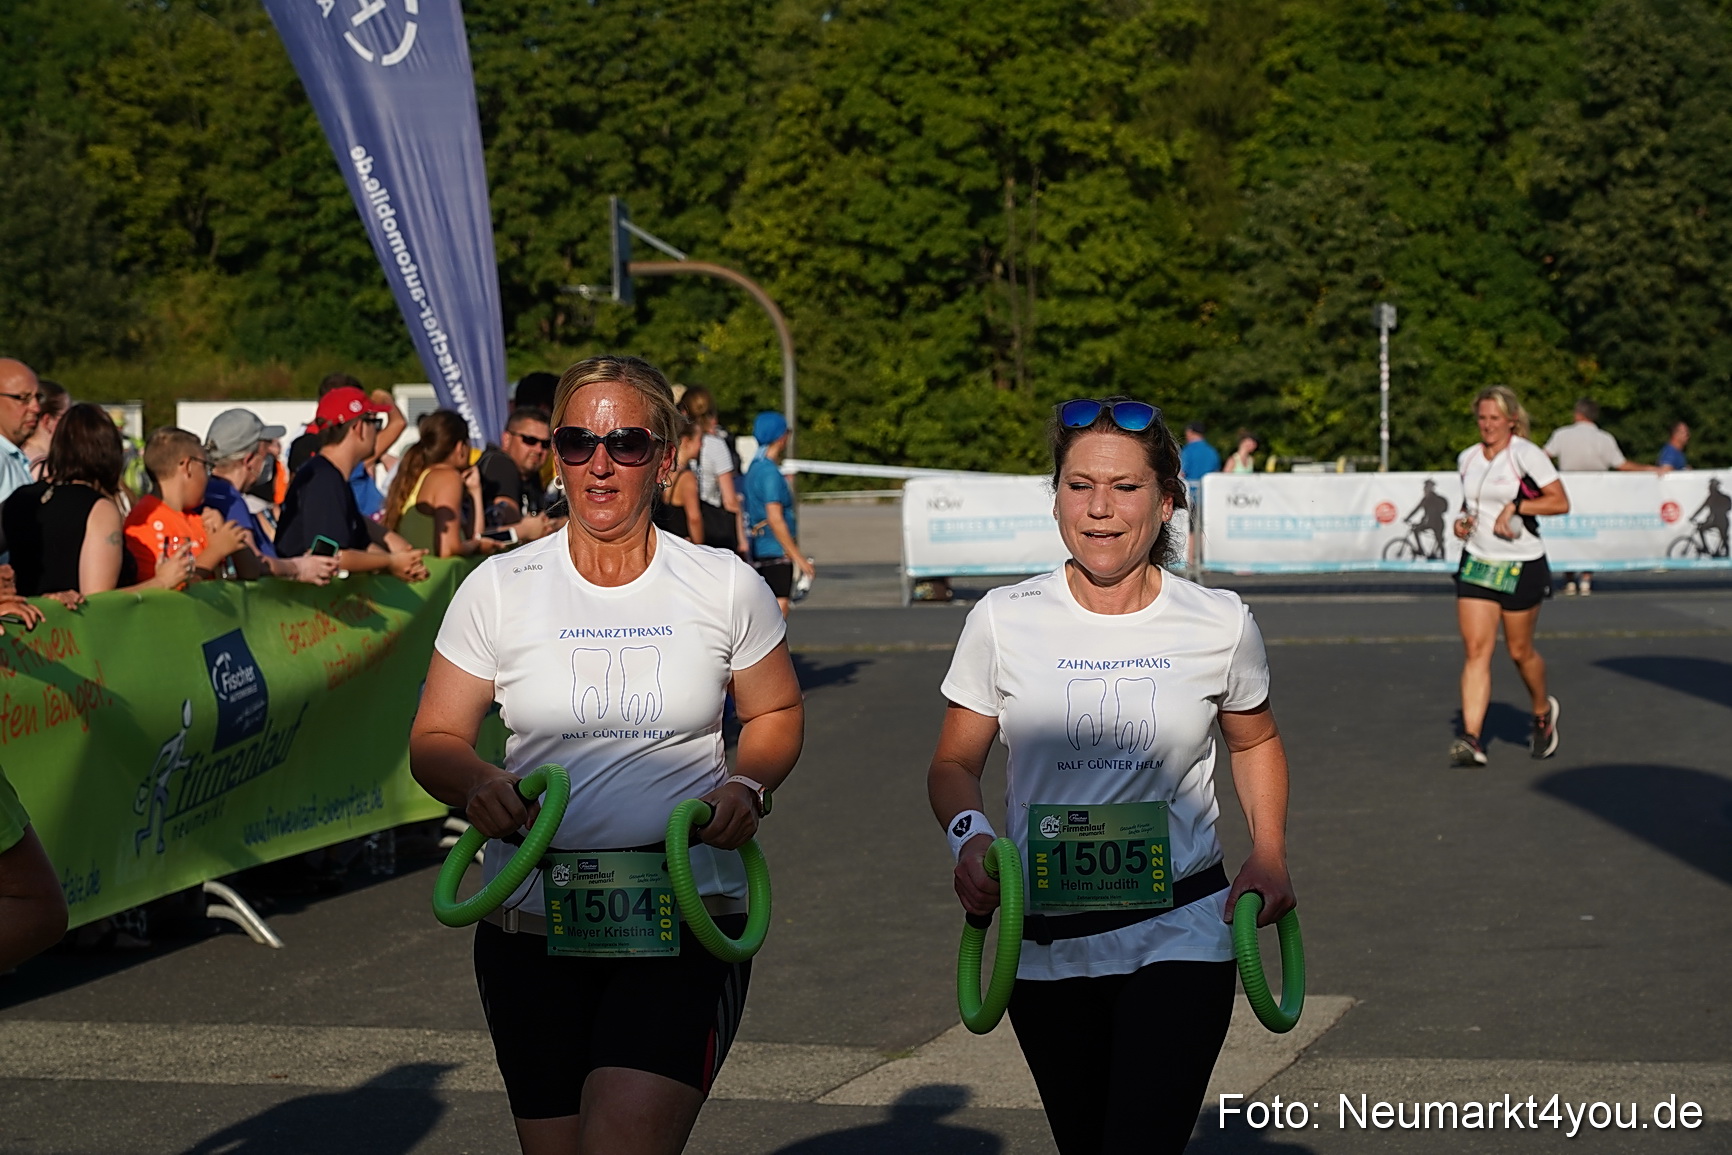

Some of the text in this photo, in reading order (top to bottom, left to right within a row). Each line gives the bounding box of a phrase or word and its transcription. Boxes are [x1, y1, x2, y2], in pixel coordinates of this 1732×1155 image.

[1020, 590, 1042, 598] JAKO
[559, 625, 673, 640] ZAHNARZTPRAXIS
[1057, 658, 1171, 671] ZAHNARZTPRAXIS
[221, 665, 257, 694] Fischer
[562, 728, 675, 740] RALF GÜNTER HELM
[1057, 757, 1164, 771] RALF GÜNTER HELM
[1062, 822, 1106, 833] Firmenlauf
[1052, 840, 1148, 875] 1505
[1036, 853, 1049, 889] RUN
[1151, 844, 1165, 892] 2022
[571, 870, 615, 881] Firmenlauf
[1061, 878, 1139, 891] Helm Judith
[563, 888, 656, 923] 1504
[551, 900, 564, 935] RUN
[659, 894, 673, 941] 2022
[567, 926, 655, 940] Meyer Kristina
